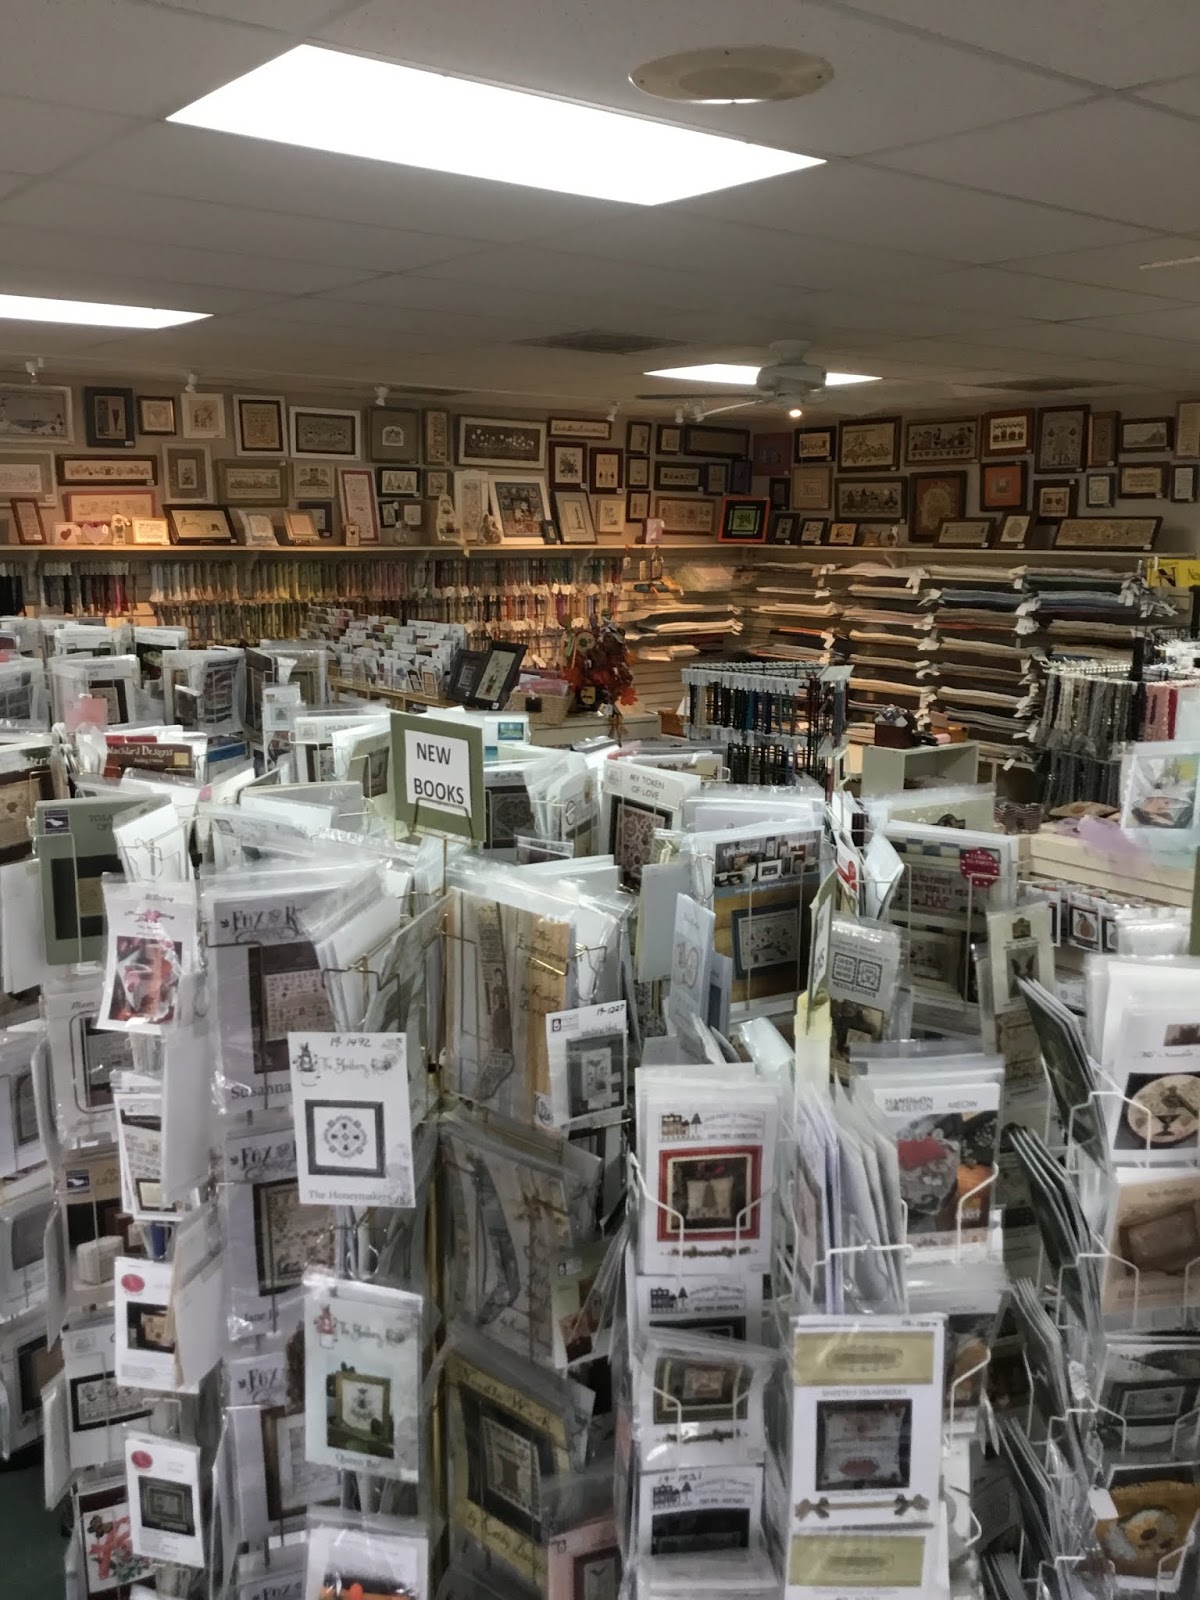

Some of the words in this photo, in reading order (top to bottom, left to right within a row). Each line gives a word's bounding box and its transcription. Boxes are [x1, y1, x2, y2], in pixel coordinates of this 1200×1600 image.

[416, 742, 451, 765] NEW
[630, 773, 640, 782] MY
[642, 776, 665, 790] TOKEN
[414, 778, 465, 804] BOOKS
[631, 785, 640, 793] OF
[642, 788, 660, 800] LOVE
[948, 1101, 978, 1109] MEOW
[308, 1189, 326, 1199] The
